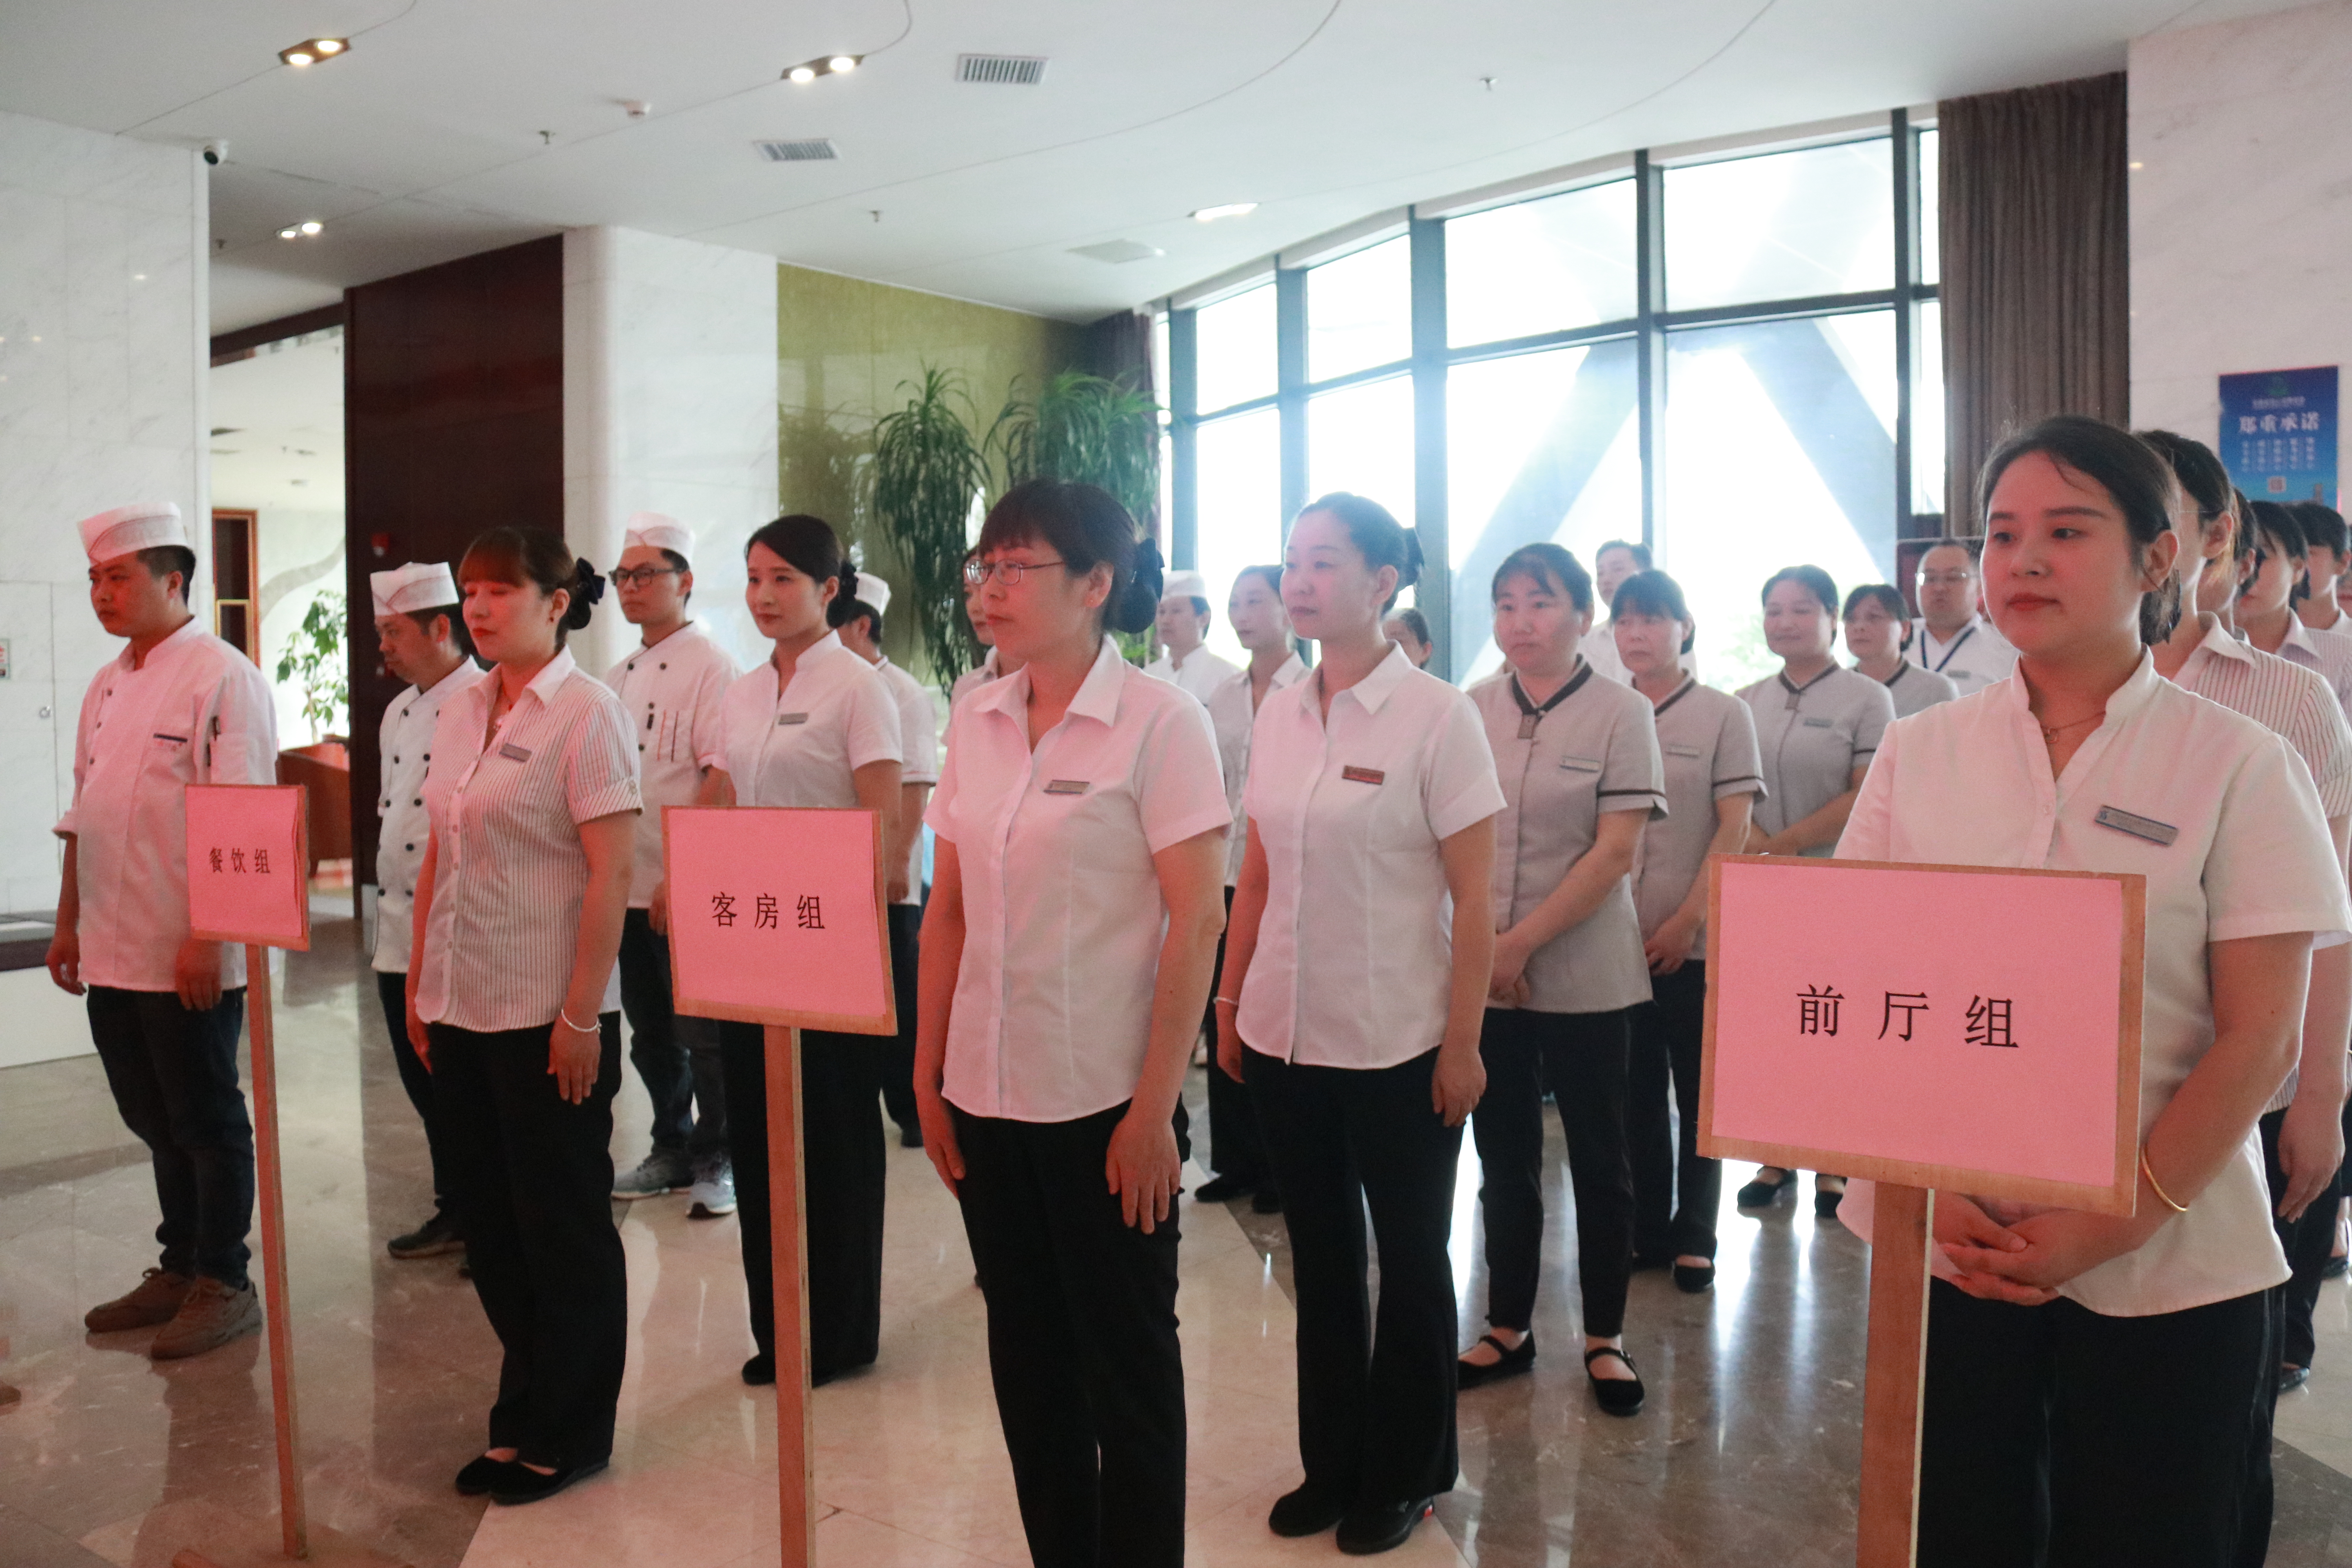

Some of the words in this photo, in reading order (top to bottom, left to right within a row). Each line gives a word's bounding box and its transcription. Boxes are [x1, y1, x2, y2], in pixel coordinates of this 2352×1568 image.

[209, 848, 270, 874] 餐饮组
[711, 891, 826, 929] 客房组
[1797, 984, 2019, 1048] 前厅组
